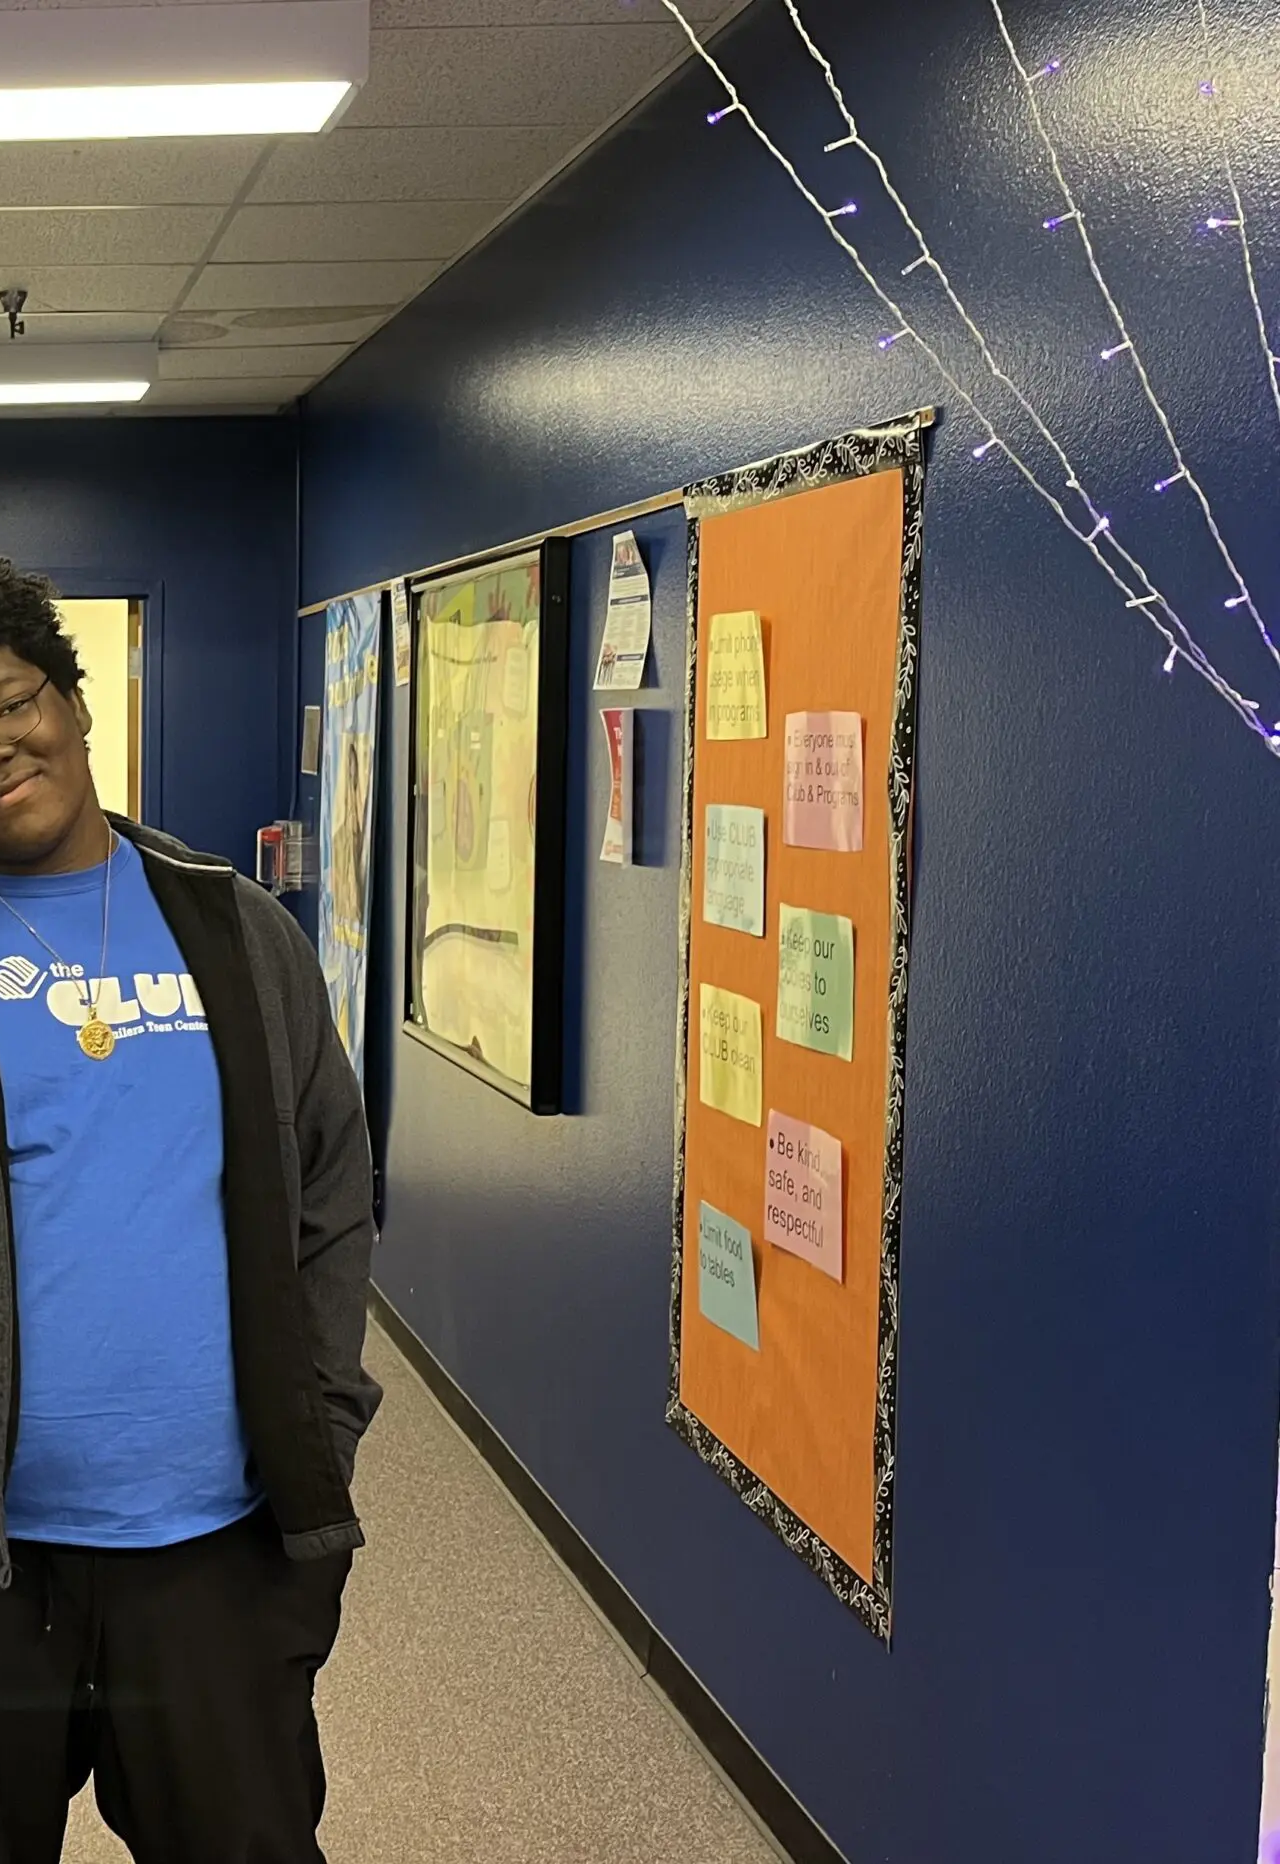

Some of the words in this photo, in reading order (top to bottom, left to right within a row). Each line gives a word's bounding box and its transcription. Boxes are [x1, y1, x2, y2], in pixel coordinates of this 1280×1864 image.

[815, 757, 823, 776] &
[807, 784, 814, 803] &
[816, 784, 860, 810] Programs
[728, 820, 757, 848] CLUB
[813, 938, 836, 961] our
[49, 962, 84, 978] the
[814, 970, 827, 996] to
[145, 1021, 174, 1033] Teen
[780, 1001, 830, 1035] ourselves
[702, 1031, 729, 1062] CLUB
[776, 1131, 795, 1160] Be
[767, 1167, 798, 1203] safe,
[801, 1184, 823, 1211] and
[767, 1203, 824, 1248] respectful
[723, 1228, 743, 1262] food
[706, 1252, 737, 1289] tables
